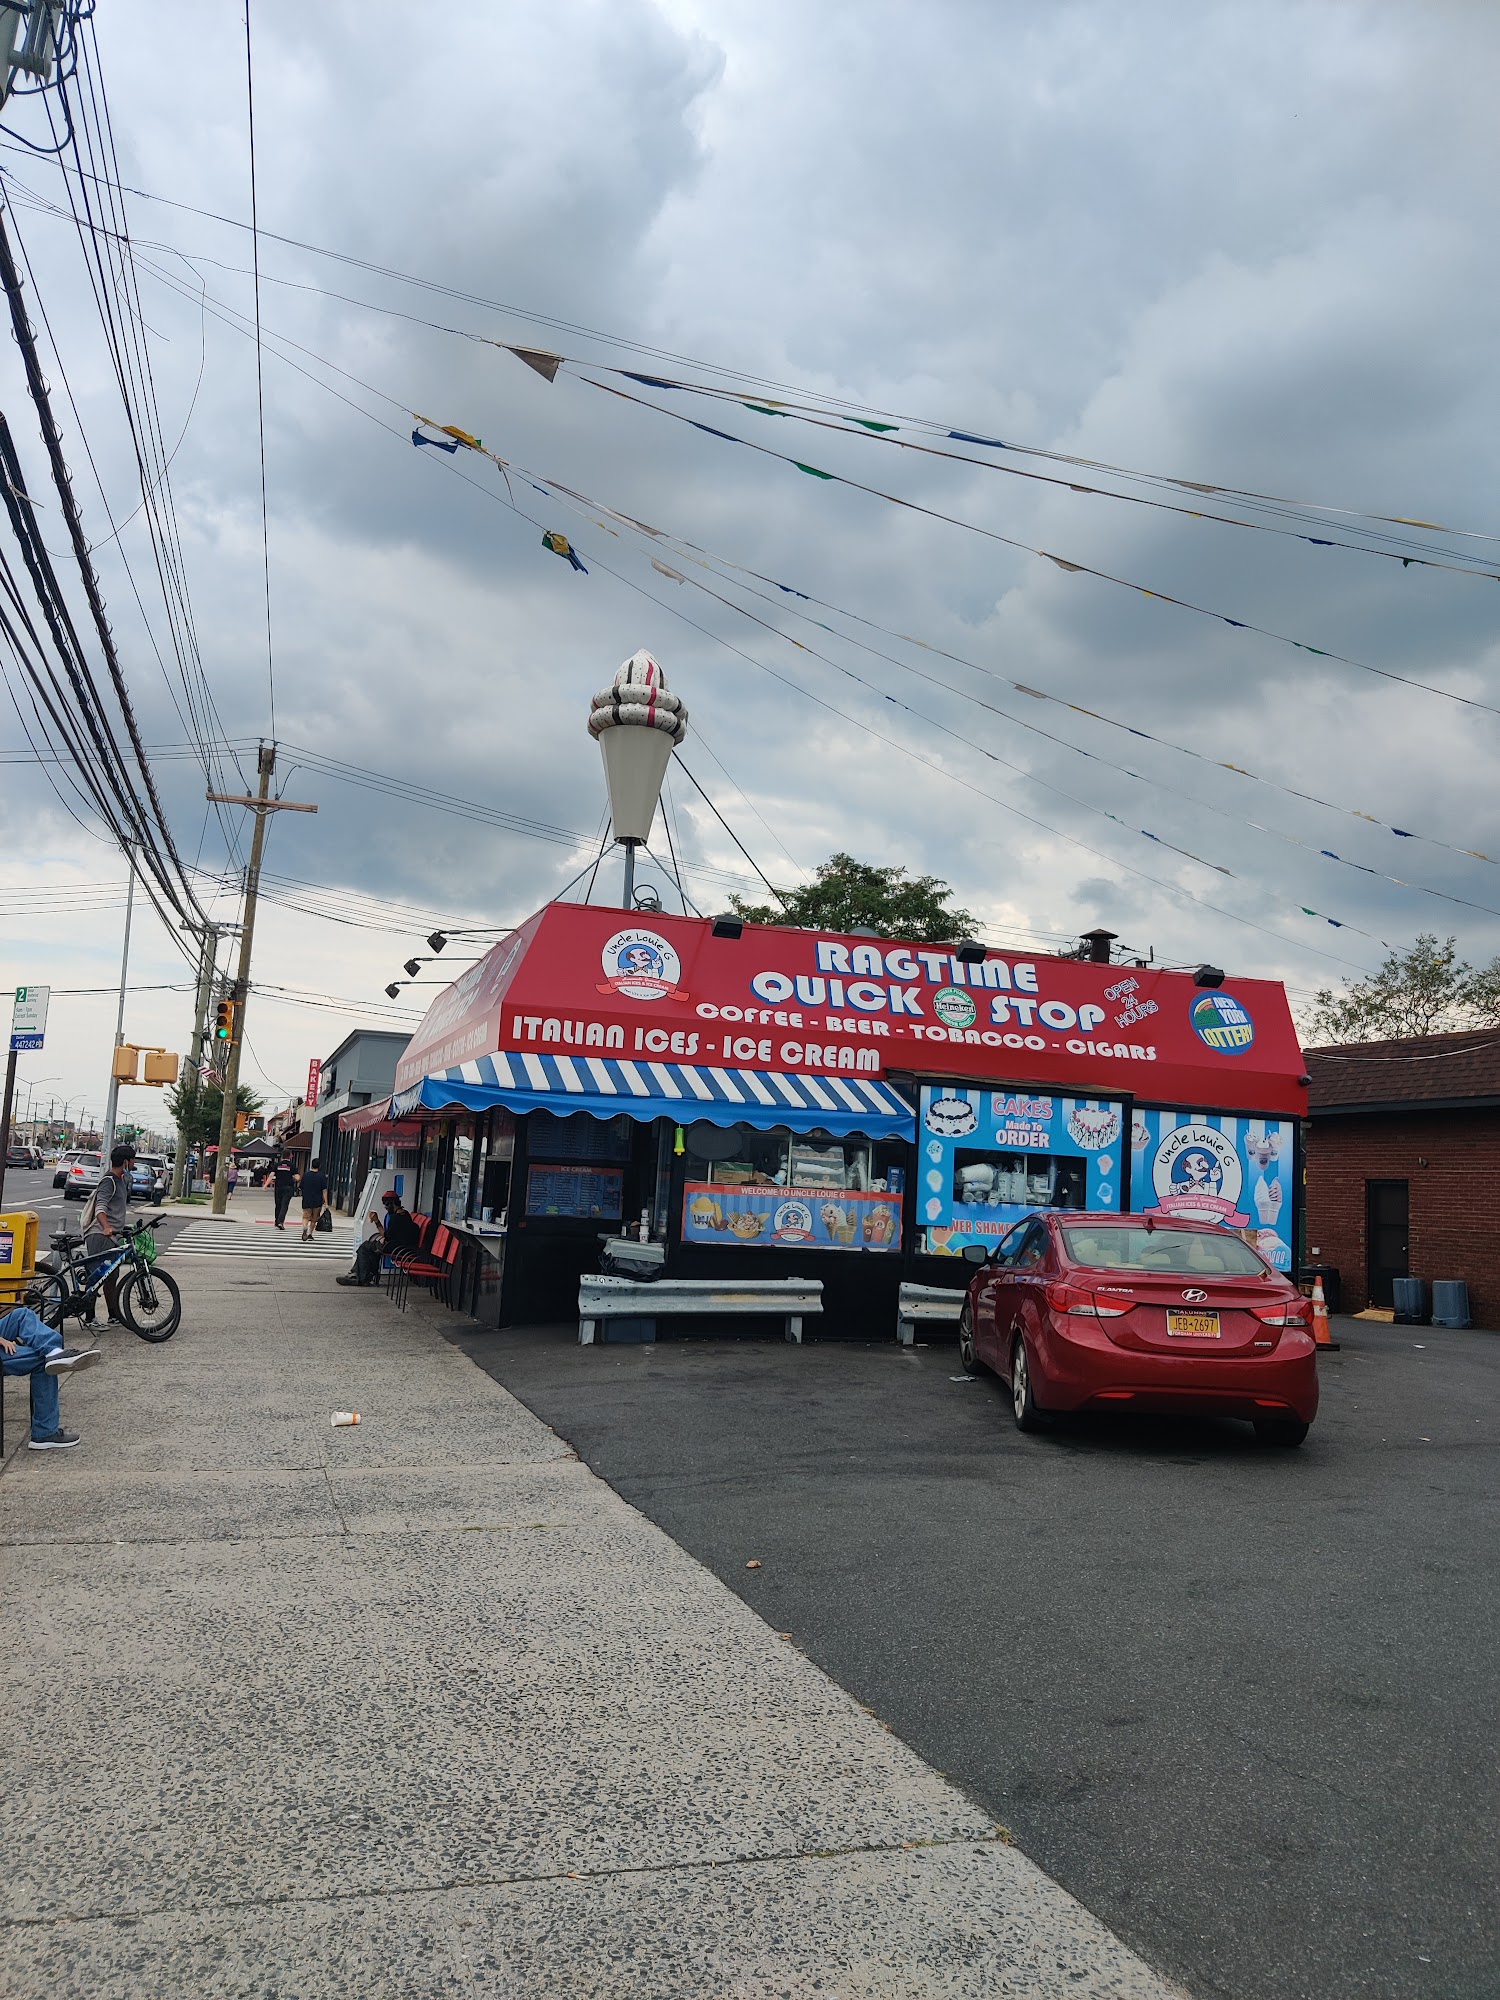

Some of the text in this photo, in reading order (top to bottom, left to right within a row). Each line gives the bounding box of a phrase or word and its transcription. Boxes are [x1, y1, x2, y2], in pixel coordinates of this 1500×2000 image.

[607, 935, 633, 955] Uncle
[636, 933, 664, 951] Louie
[816, 941, 1039, 994] RAGTIME
[18, 988, 25, 1001] 2
[1103, 976, 1140, 1001] OPEN
[751, 971, 1105, 1033] QUICK STOP
[935, 1002, 975, 1013] Heineken
[1121, 993, 1138, 1009] 24
[1212, 997, 1237, 1009] NEW
[1114, 999, 1158, 1029] HOURS
[1218, 1008, 1248, 1025] YORK
[695, 1003, 804, 1029] COFFEE
[825, 1016, 890, 1037] BEER
[908, 1024, 1046, 1050] TOBACCO
[1065, 1039, 1157, 1061] CIGARS
[1199, 1024, 1252, 1048] LOTTERY
[512, 1015, 625, 1049] ITALIAN
[634, 1027, 699, 1056] ICES
[722, 1035, 772, 1063] ICE
[780, 1041, 880, 1072] CREAM
[308, 1060, 318, 1106] BAKERY
[993, 1097, 1053, 1119] CAKES
[1005, 1120, 1043, 1131] Made To
[995, 1129, 1050, 1148] ORDER
[1159, 1130, 1235, 1167] Uncle Louie G
[741, 1187, 846, 1199] WELCOME TO UNCLE LOUIE G
[1166, 1201, 1185, 1209] ITALIAN
[1210, 1203, 1227, 1213] CREAM
[1097, 1286, 1134, 1294] ELANTRA
